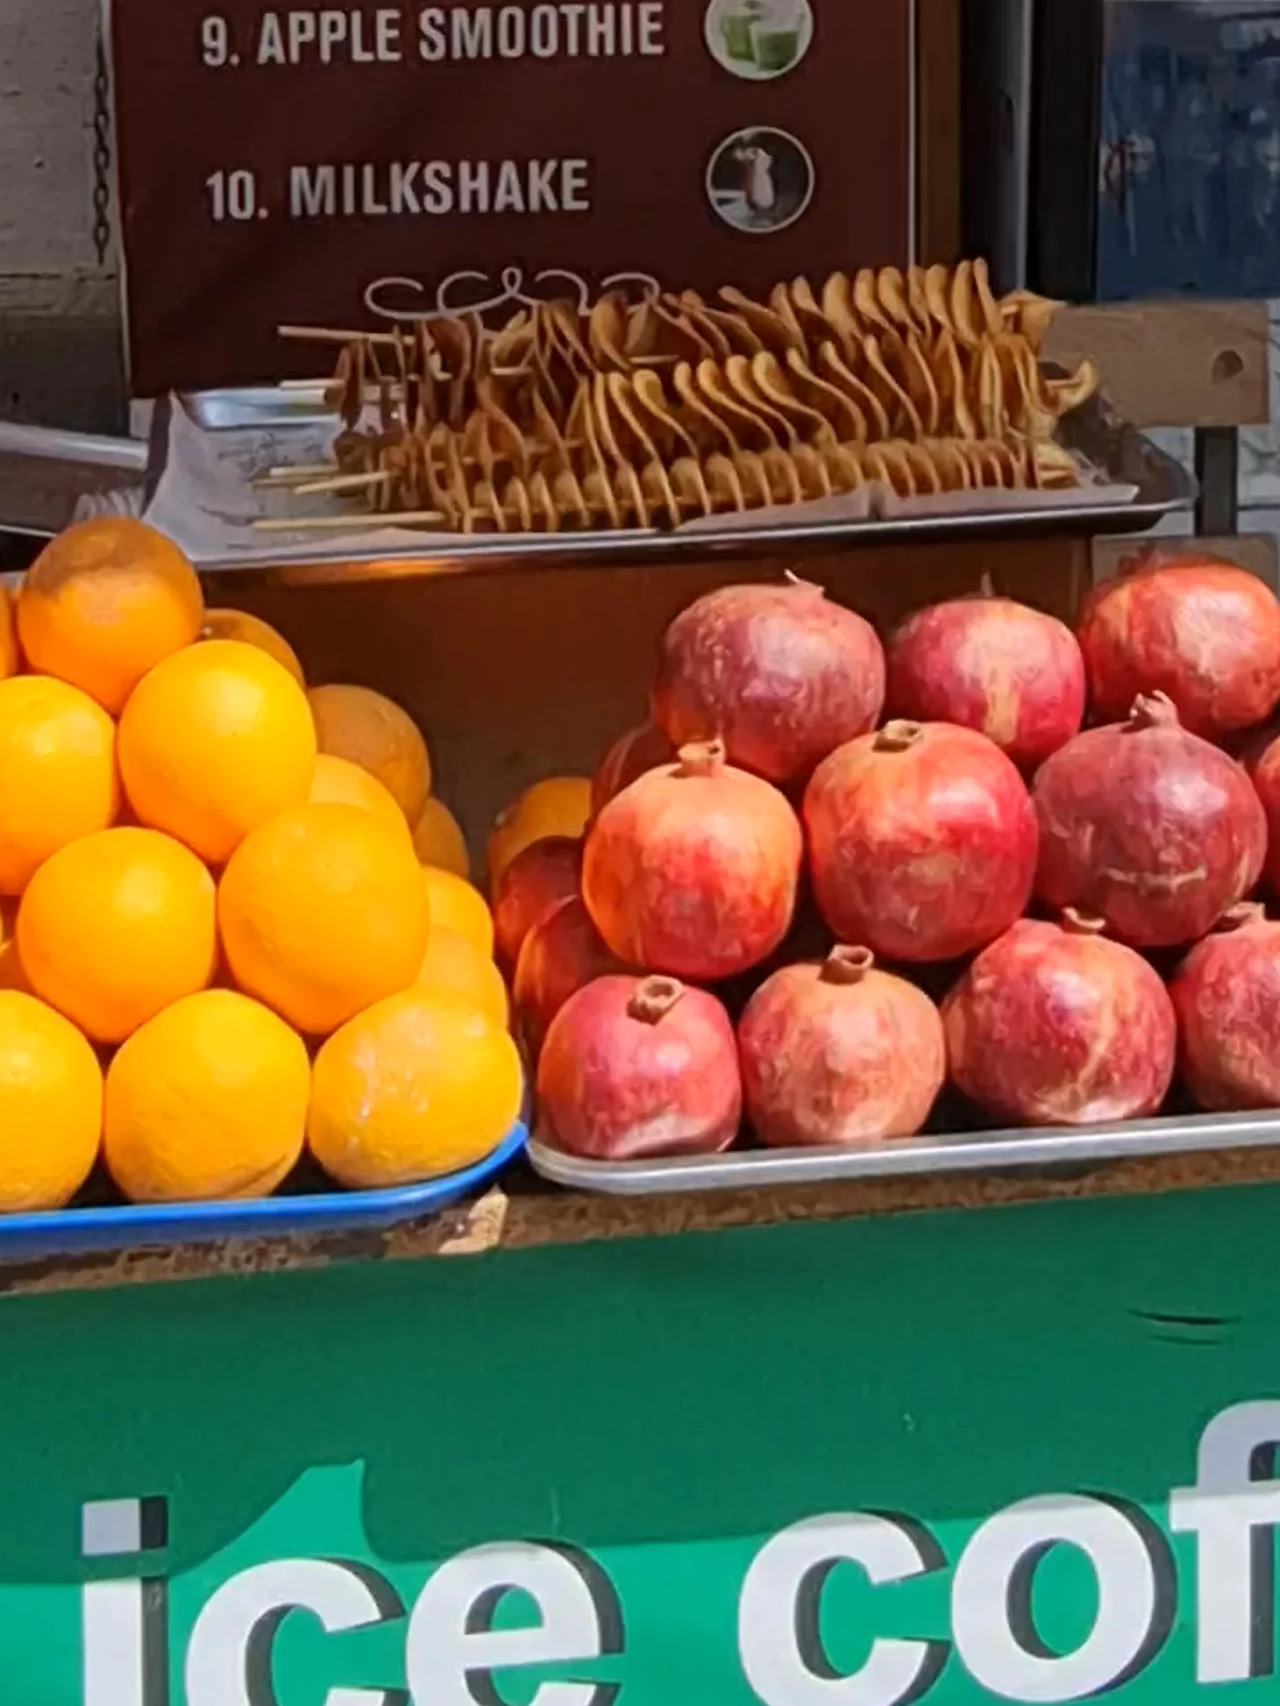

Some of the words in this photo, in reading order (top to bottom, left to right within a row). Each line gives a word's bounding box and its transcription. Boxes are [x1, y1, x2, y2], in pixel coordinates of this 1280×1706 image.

[201, 15, 240, 67] 9.
[256, 7, 403, 65] APPLE
[418, 1, 665, 62] SMOOTHIE
[205, 168, 269, 221] 10.
[289, 158, 590, 217] MILKSHAKE
